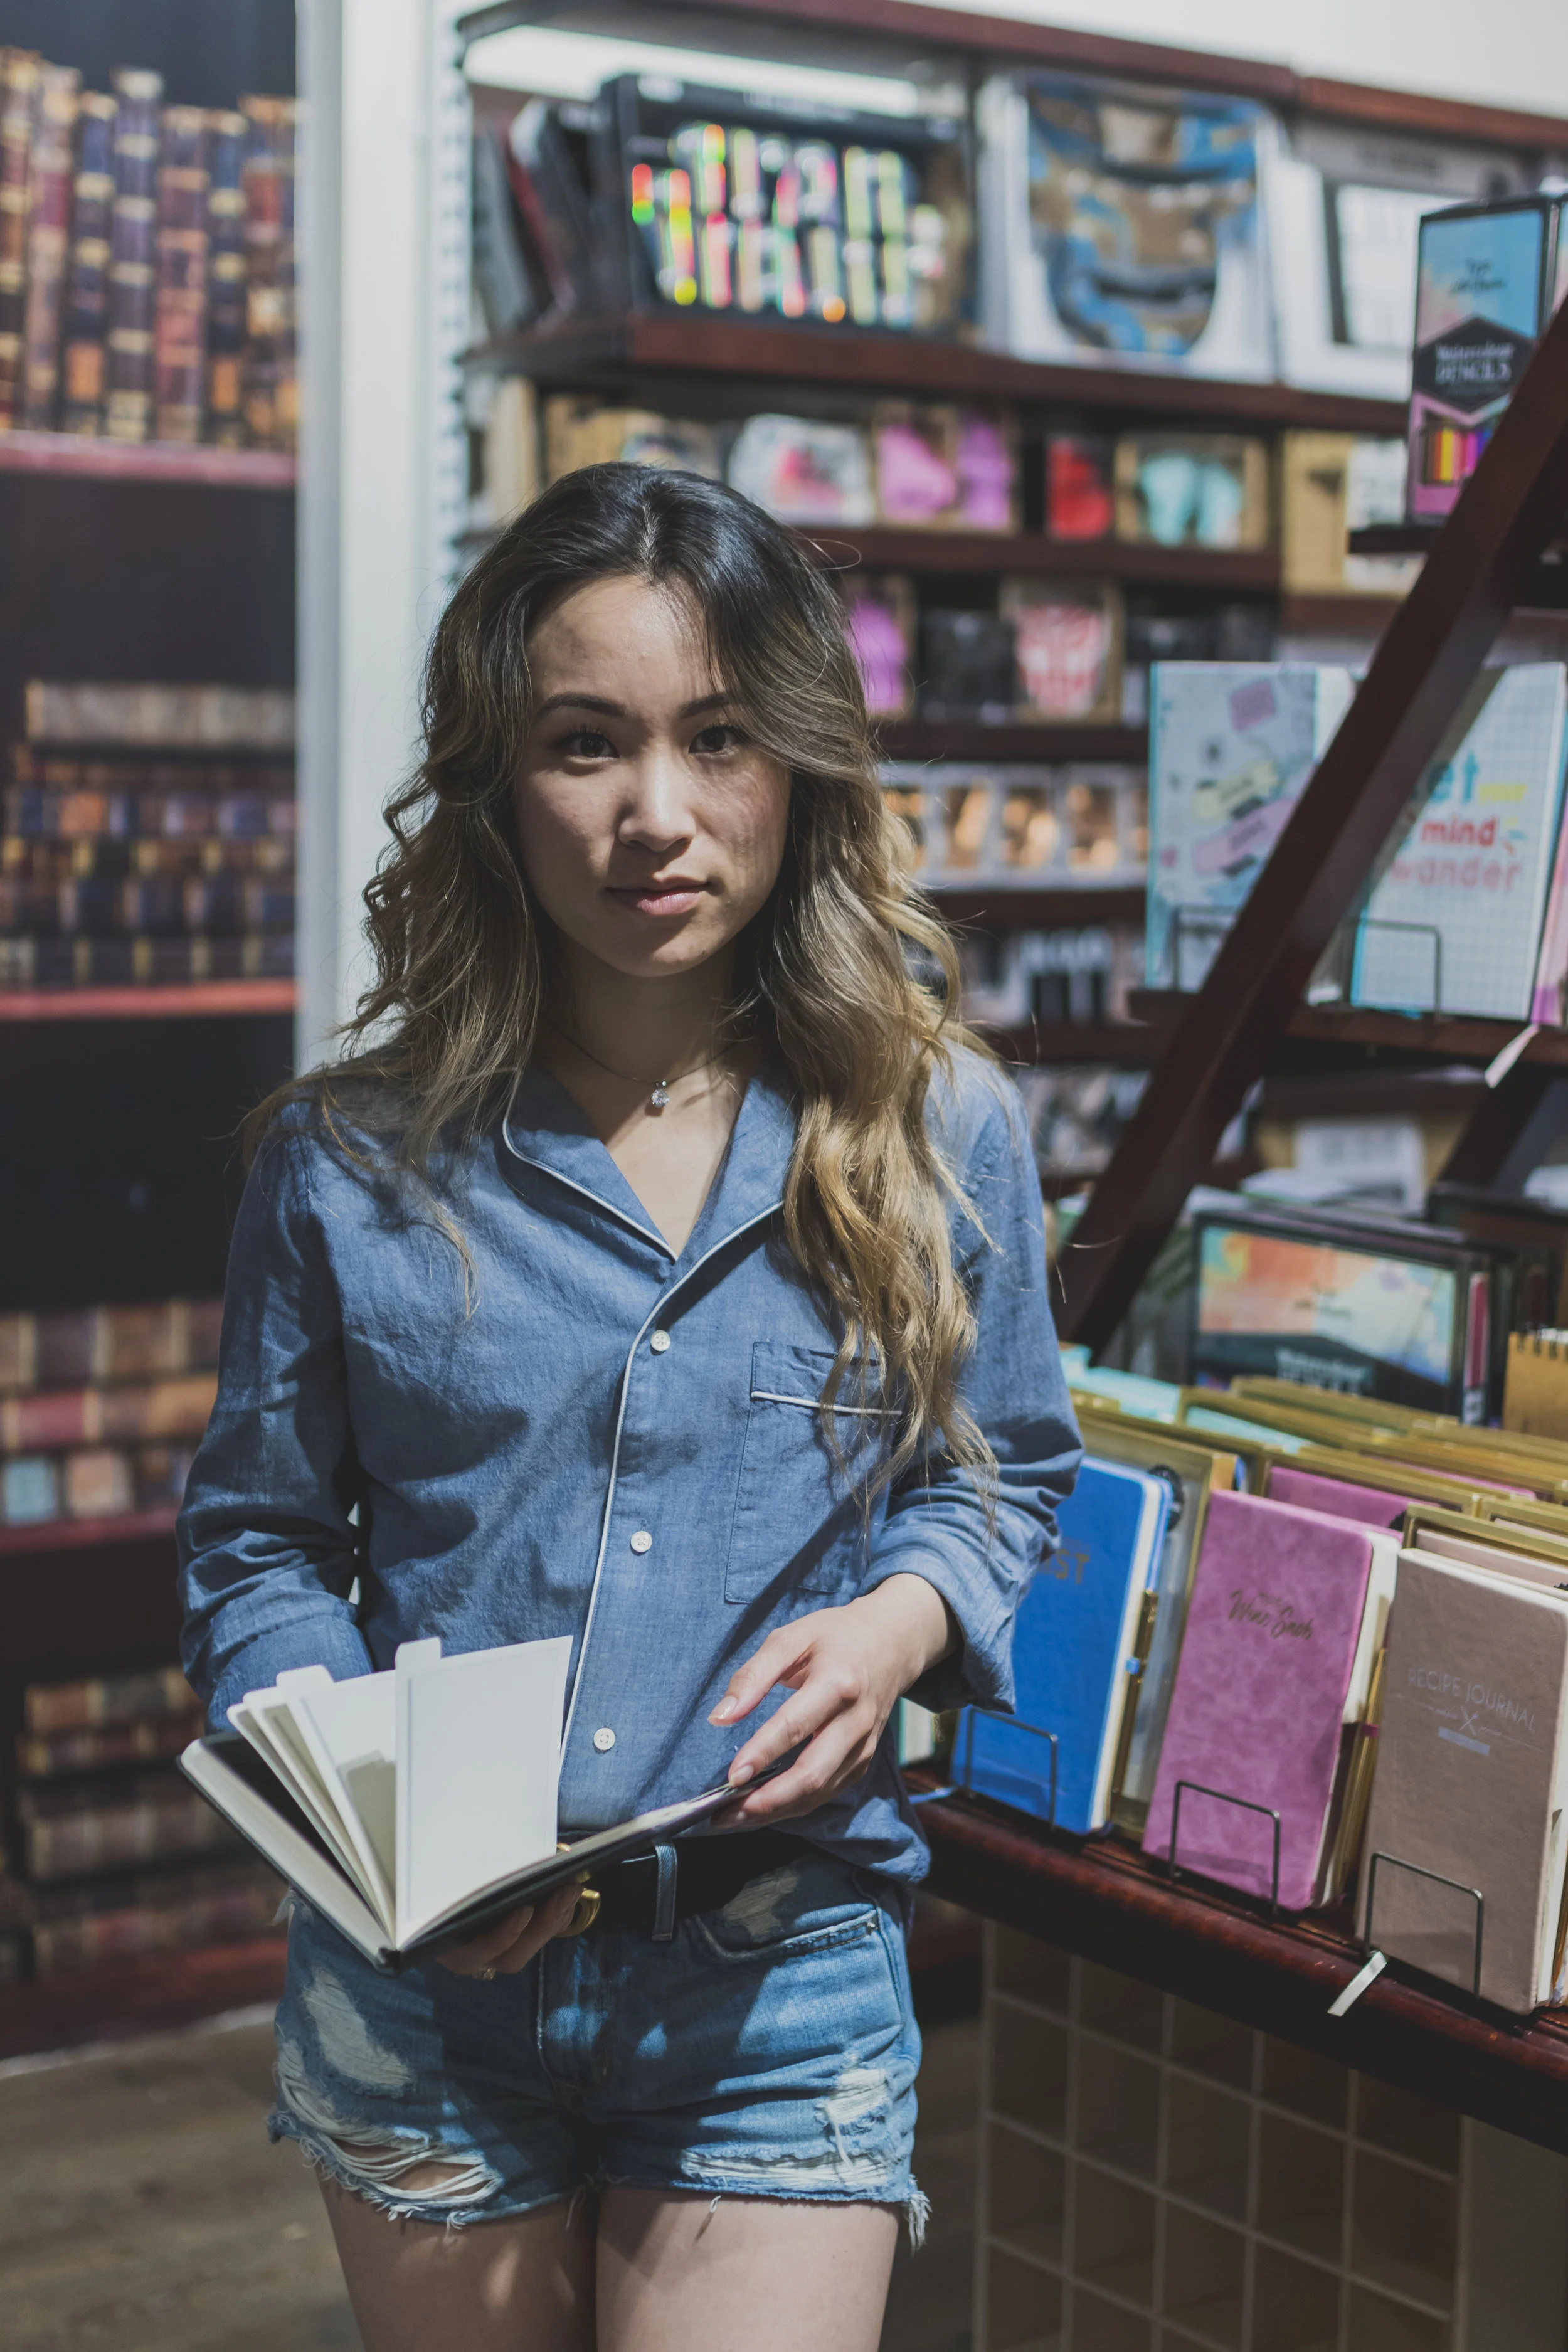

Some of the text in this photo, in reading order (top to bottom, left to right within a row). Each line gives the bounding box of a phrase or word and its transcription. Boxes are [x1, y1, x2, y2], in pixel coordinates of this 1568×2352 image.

[1421, 813, 1497, 849] mind
[1407, 1668, 1536, 1734] RECIPE JOURNAL
